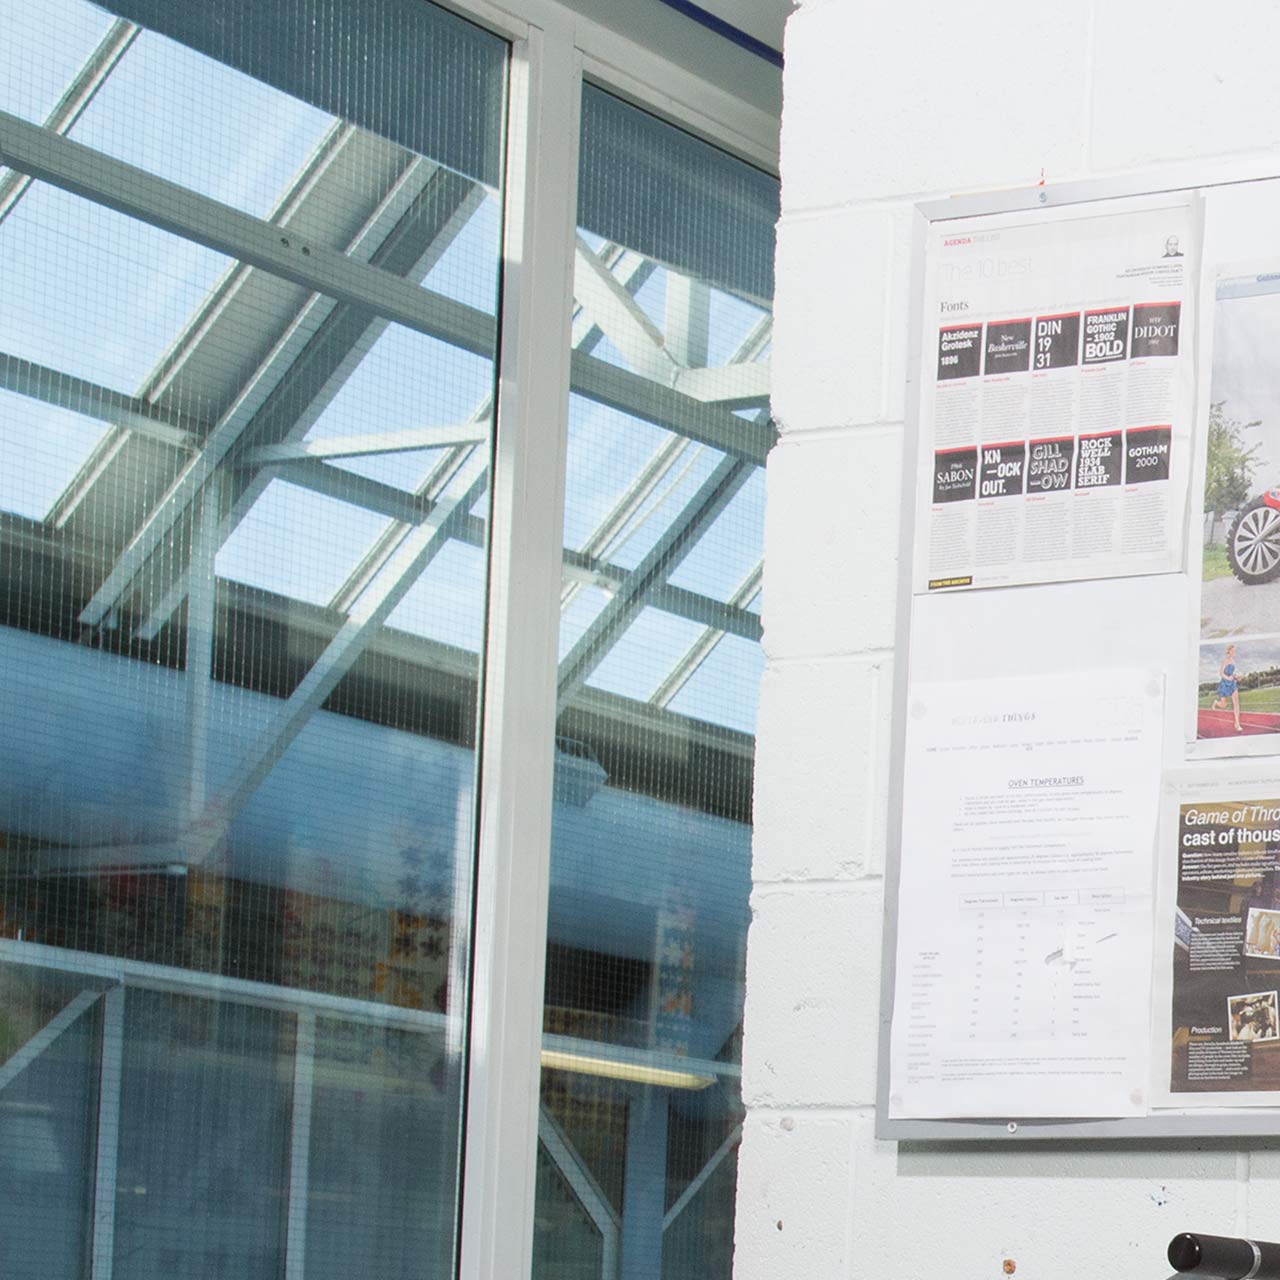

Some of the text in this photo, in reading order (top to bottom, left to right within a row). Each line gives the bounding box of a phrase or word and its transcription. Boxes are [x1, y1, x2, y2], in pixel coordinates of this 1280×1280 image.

[942, 263, 973, 281] The
[940, 301, 969, 313] Fonts
[1087, 312, 1127, 325] FRANKLIN
[1038, 320, 1062, 337] DIN
[1086, 323, 1117, 334] GOTHIC
[1134, 325, 1177, 339] DIDOT
[941, 330, 979, 342] Akzidenz
[1001, 334, 1015, 342] New
[1093, 332, 1115, 343] 1902
[941, 340, 973, 351] Grotesk
[988, 341, 1028, 354] Baskerville
[1037, 338, 1052, 352] 19
[1085, 341, 1123, 358] BOLD
[1036, 353, 1051, 368] 31
[1081, 437, 1112, 450] ROCK
[984, 449, 1001, 465] KN
[1033, 443, 1062, 460] GILL
[1080, 447, 1111, 459] WELL
[1128, 444, 1168, 459] GOTHAM
[1030, 458, 1069, 475] SHAD
[1079, 456, 1101, 467] 1934
[1135, 456, 1159, 468] 2000
[936, 468, 975, 484] SABON
[1078, 465, 1106, 477] SLAB
[1077, 475, 1110, 487] SERIF
[982, 480, 1007, 496] OUT.
[1008, 776, 1084, 787] OVEN TEMPERATURES
[1185, 809, 1229, 826] Game
[1231, 806, 1248, 823] of
[1182, 830, 1216, 846] cast
[1219, 828, 1235, 844] of
[1195, 916, 1242, 925] Technical textiles
[1191, 1026, 1222, 1034] Production
